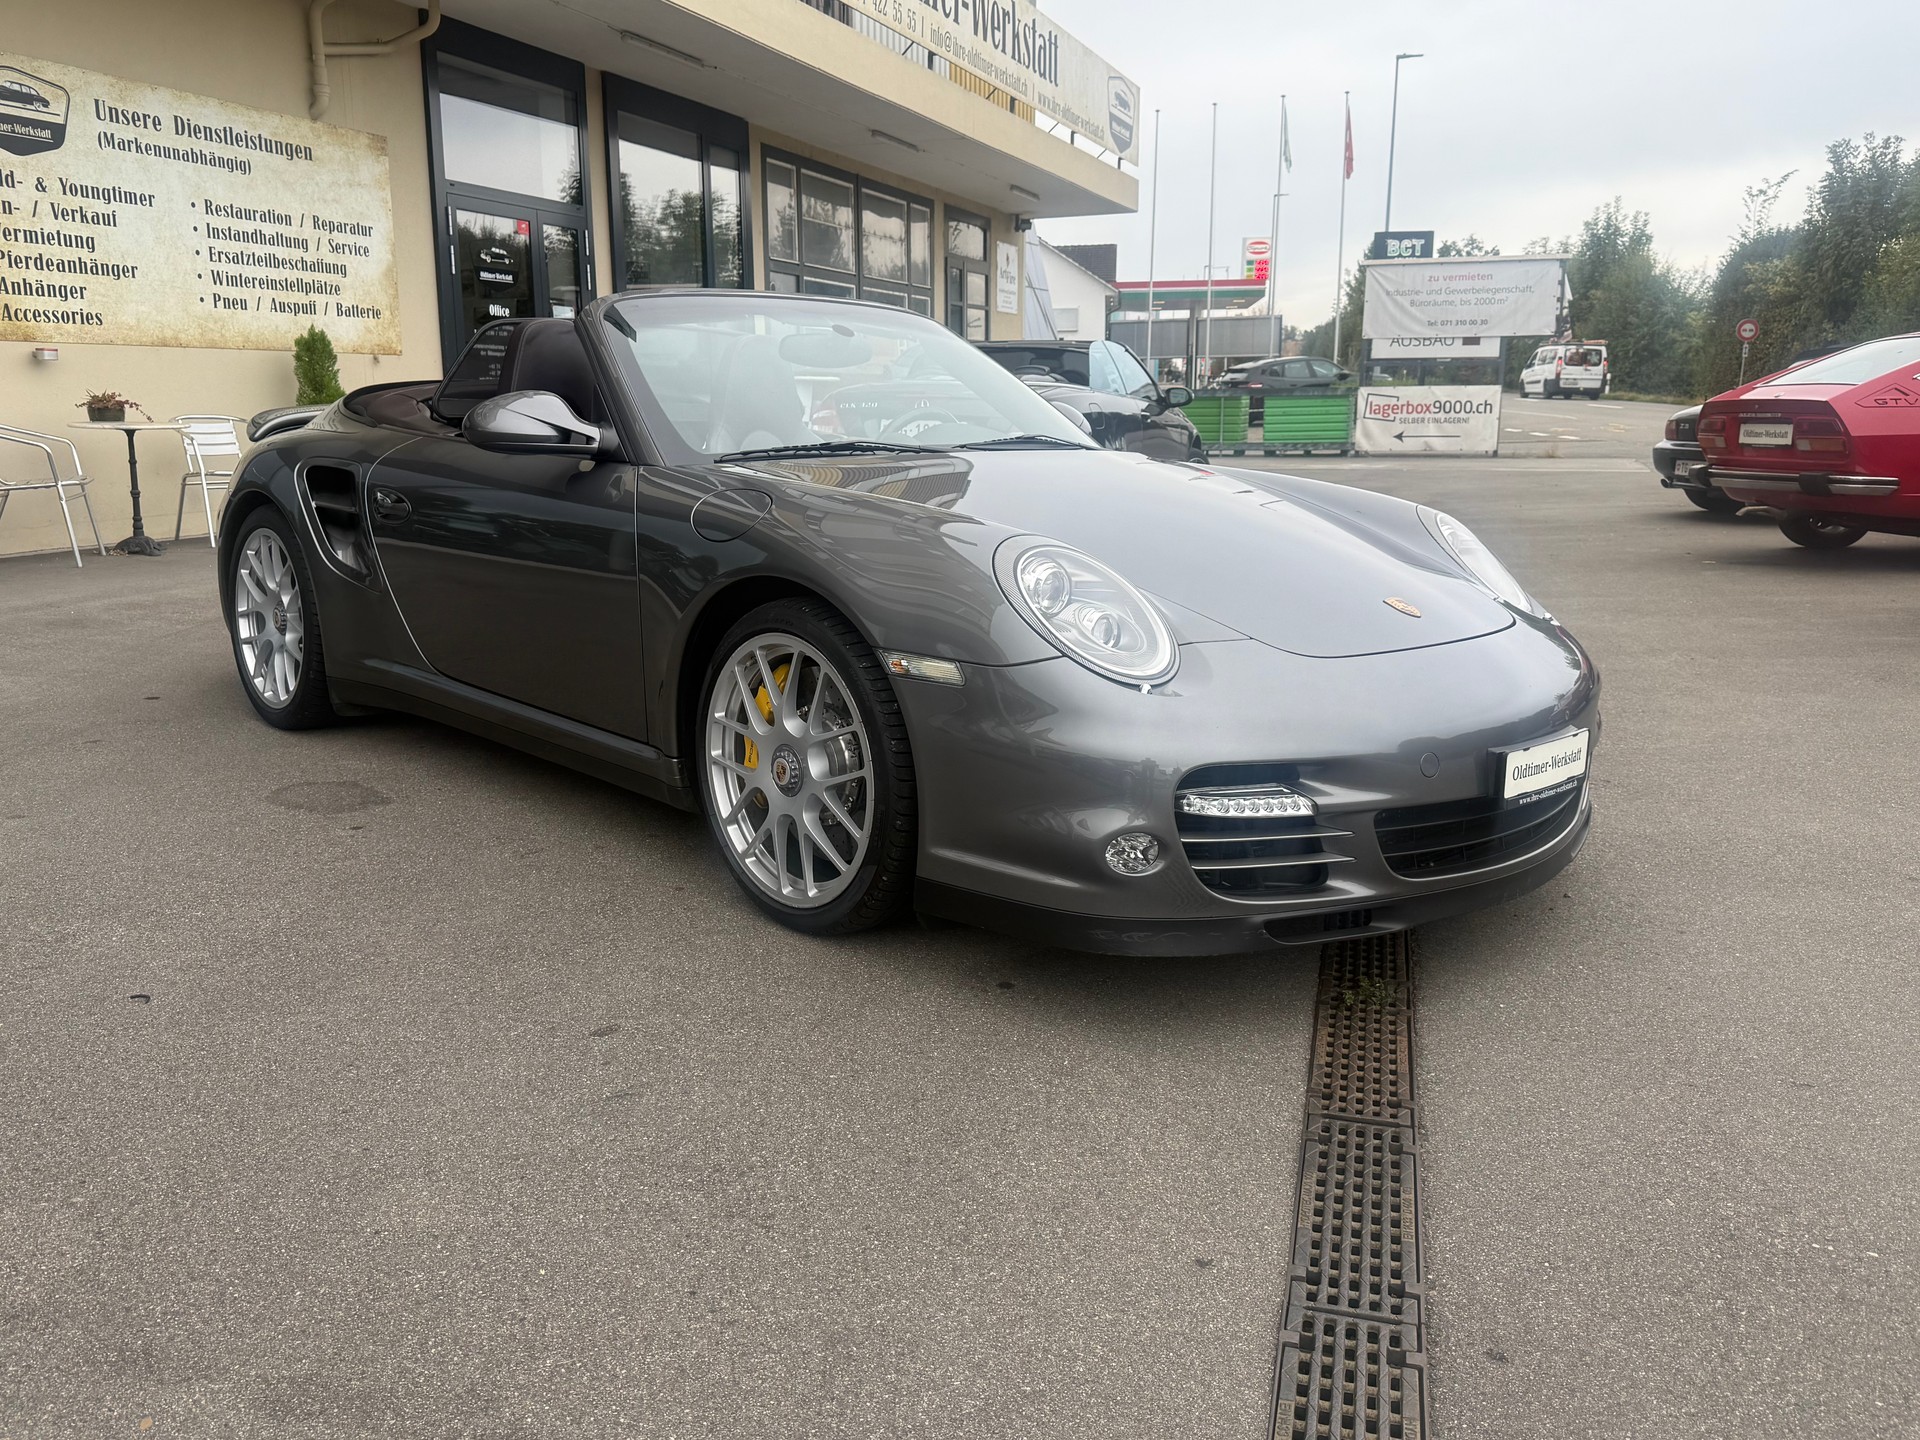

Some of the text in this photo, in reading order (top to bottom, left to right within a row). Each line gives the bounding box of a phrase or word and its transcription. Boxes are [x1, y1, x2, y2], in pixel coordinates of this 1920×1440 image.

[893, 0, 903, 24] 55
[907, 8, 916, 33] 55
[922, 0, 1059, 86] -Werkstatt
[94, 98, 314, 162] Unsere Dienstleistungen
[98, 131, 252, 176] (Markenunabhängig)
[35, 176, 48, 193] &
[58, 176, 156, 208] Youngtimer
[0, 200, 118, 228] n- / Verkauf
[204, 199, 292, 228] Restauration
[312, 214, 374, 239] Reparatur
[0, 222, 96, 254] ermietung
[205, 222, 309, 253] Instandhaltung
[328, 238, 371, 259] Service
[1386, 239, 1425, 257] BCT
[208, 245, 348, 279] Ersatzteilbeschaffung
[0, 275, 87, 302] Anhänger
[210, 268, 342, 298] Wintereinstellplätze
[1385, 285, 1535, 296] Industrie- und Gewerbeliegenschaft,
[1442, 272, 1493, 282] vermieten
[1, 302, 104, 327] Accessories
[213, 292, 249, 312] Pneu
[269, 296, 318, 317] Auspuff
[336, 302, 382, 321] Batterie
[489, 303, 510, 317] Office
[1409, 299, 1457, 308] Büroräume,
[1459, 298, 1472, 306] bis
[1389, 337, 1454, 347] AUSBAU
[1368, 398, 1493, 418] lagerbox9000.ch
[1398, 416, 1470, 425] SELBER EINLAGERN!
[1743, 429, 1788, 439] Oldtimer-Werkstatt
[1513, 747, 1582, 781] Oldtimer-Werkstatt
